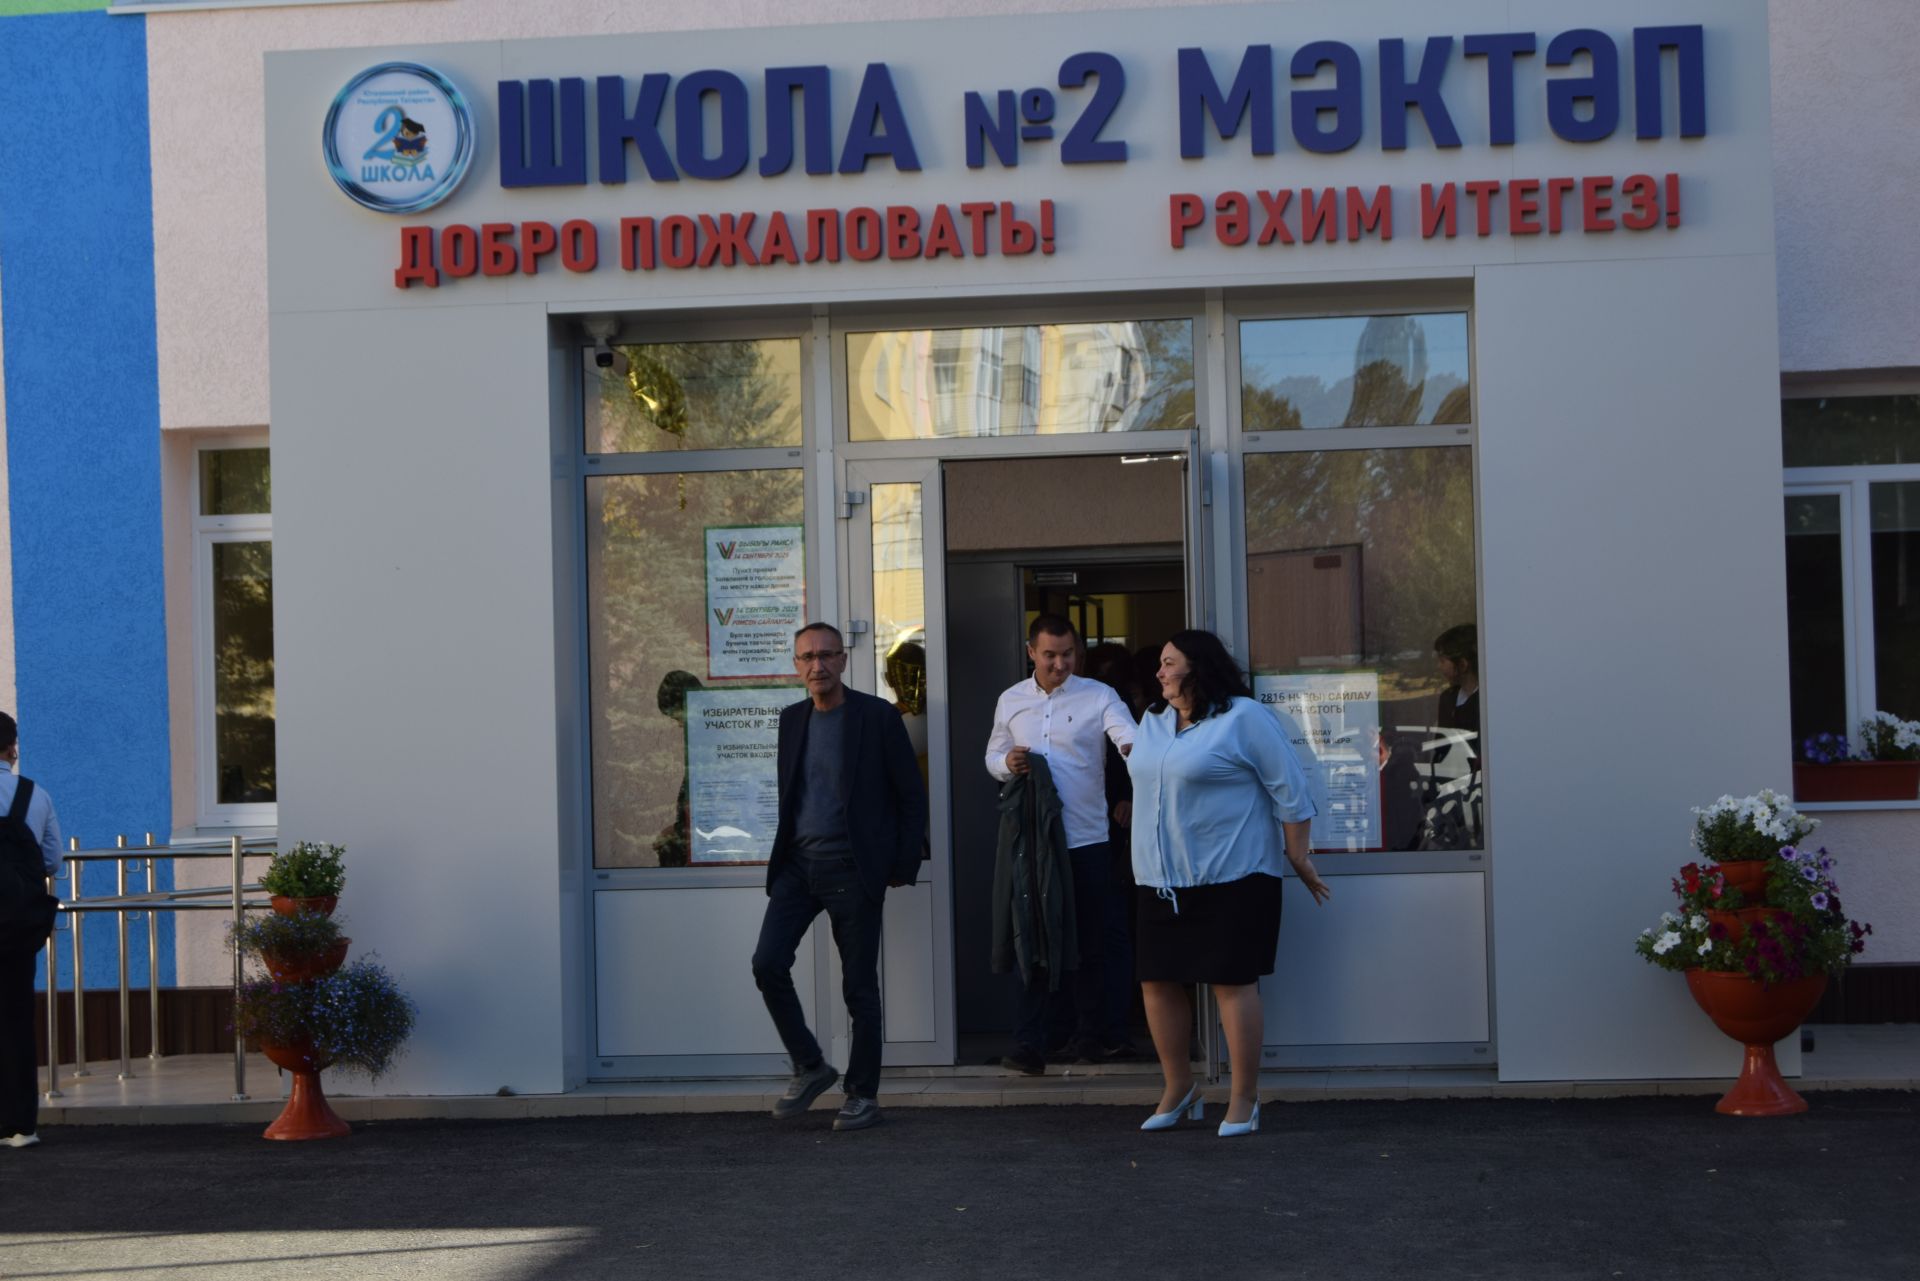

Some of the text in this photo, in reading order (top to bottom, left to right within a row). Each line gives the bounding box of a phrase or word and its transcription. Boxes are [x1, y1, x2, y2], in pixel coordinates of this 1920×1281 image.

[498, 24, 1707, 188] ШКОЛА №2 МӘКТӘП
[363, 105, 406, 160] 2
[361, 163, 435, 183] ШКОЛА
[1169, 172, 1681, 250] РӘХИМ ИТЕГЕЗ!
[394, 199, 1056, 289] ДОБРО ПОЖАЛОВАТЬ!
[703, 705, 787, 718] ИЗБИРАТЕЛЬНЫ
[1261, 691, 1286, 703] 2816
[705, 719, 751, 730] УЧАСТОК
[767, 718, 779, 729] 28
